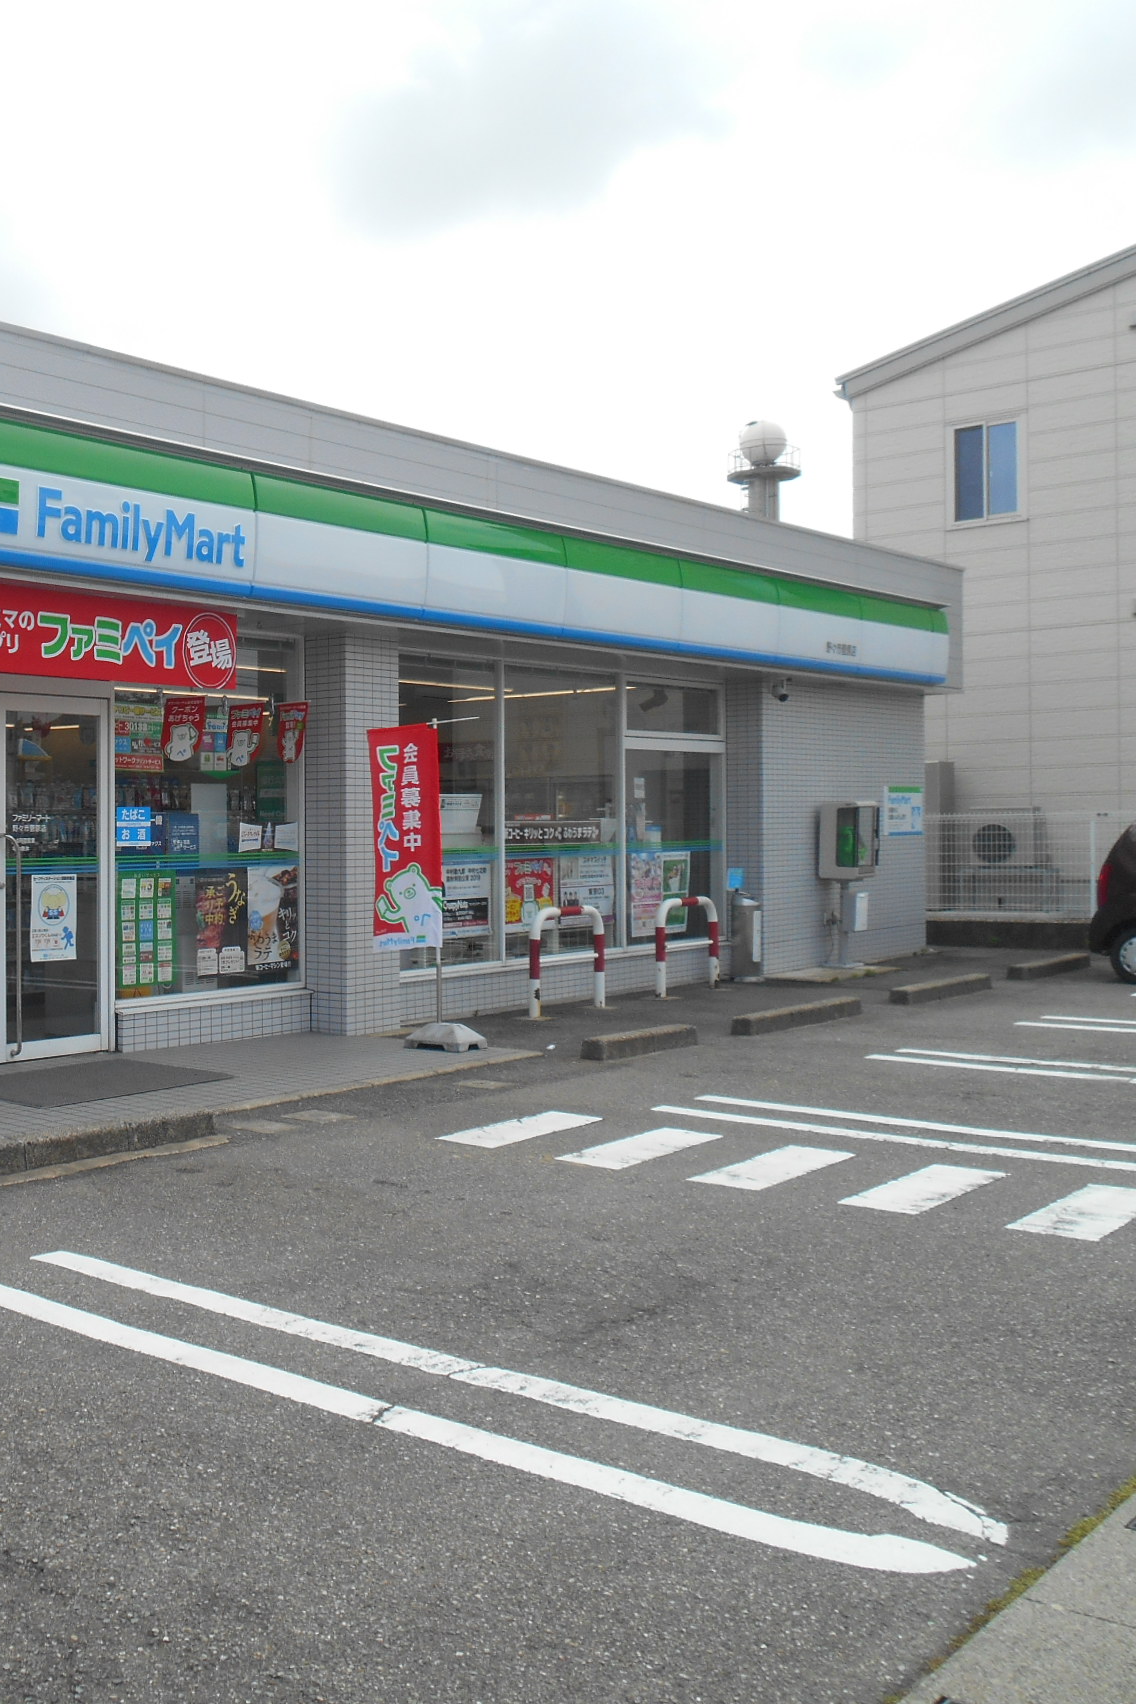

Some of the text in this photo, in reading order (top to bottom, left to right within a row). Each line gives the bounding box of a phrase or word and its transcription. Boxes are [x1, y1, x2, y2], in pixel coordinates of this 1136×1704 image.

[37, 486, 246, 568] FamilyMart
[37, 611, 182, 669] ファミペイ
[186, 629, 233, 670] 登場
[167, 714, 200, 722] あげちゃう
[12, 814, 51, 823] ファミリーマート
[121, 808, 146, 821] たばこ
[226, 872, 246, 925] うなぎ
[255, 947, 273, 960] ラテ
